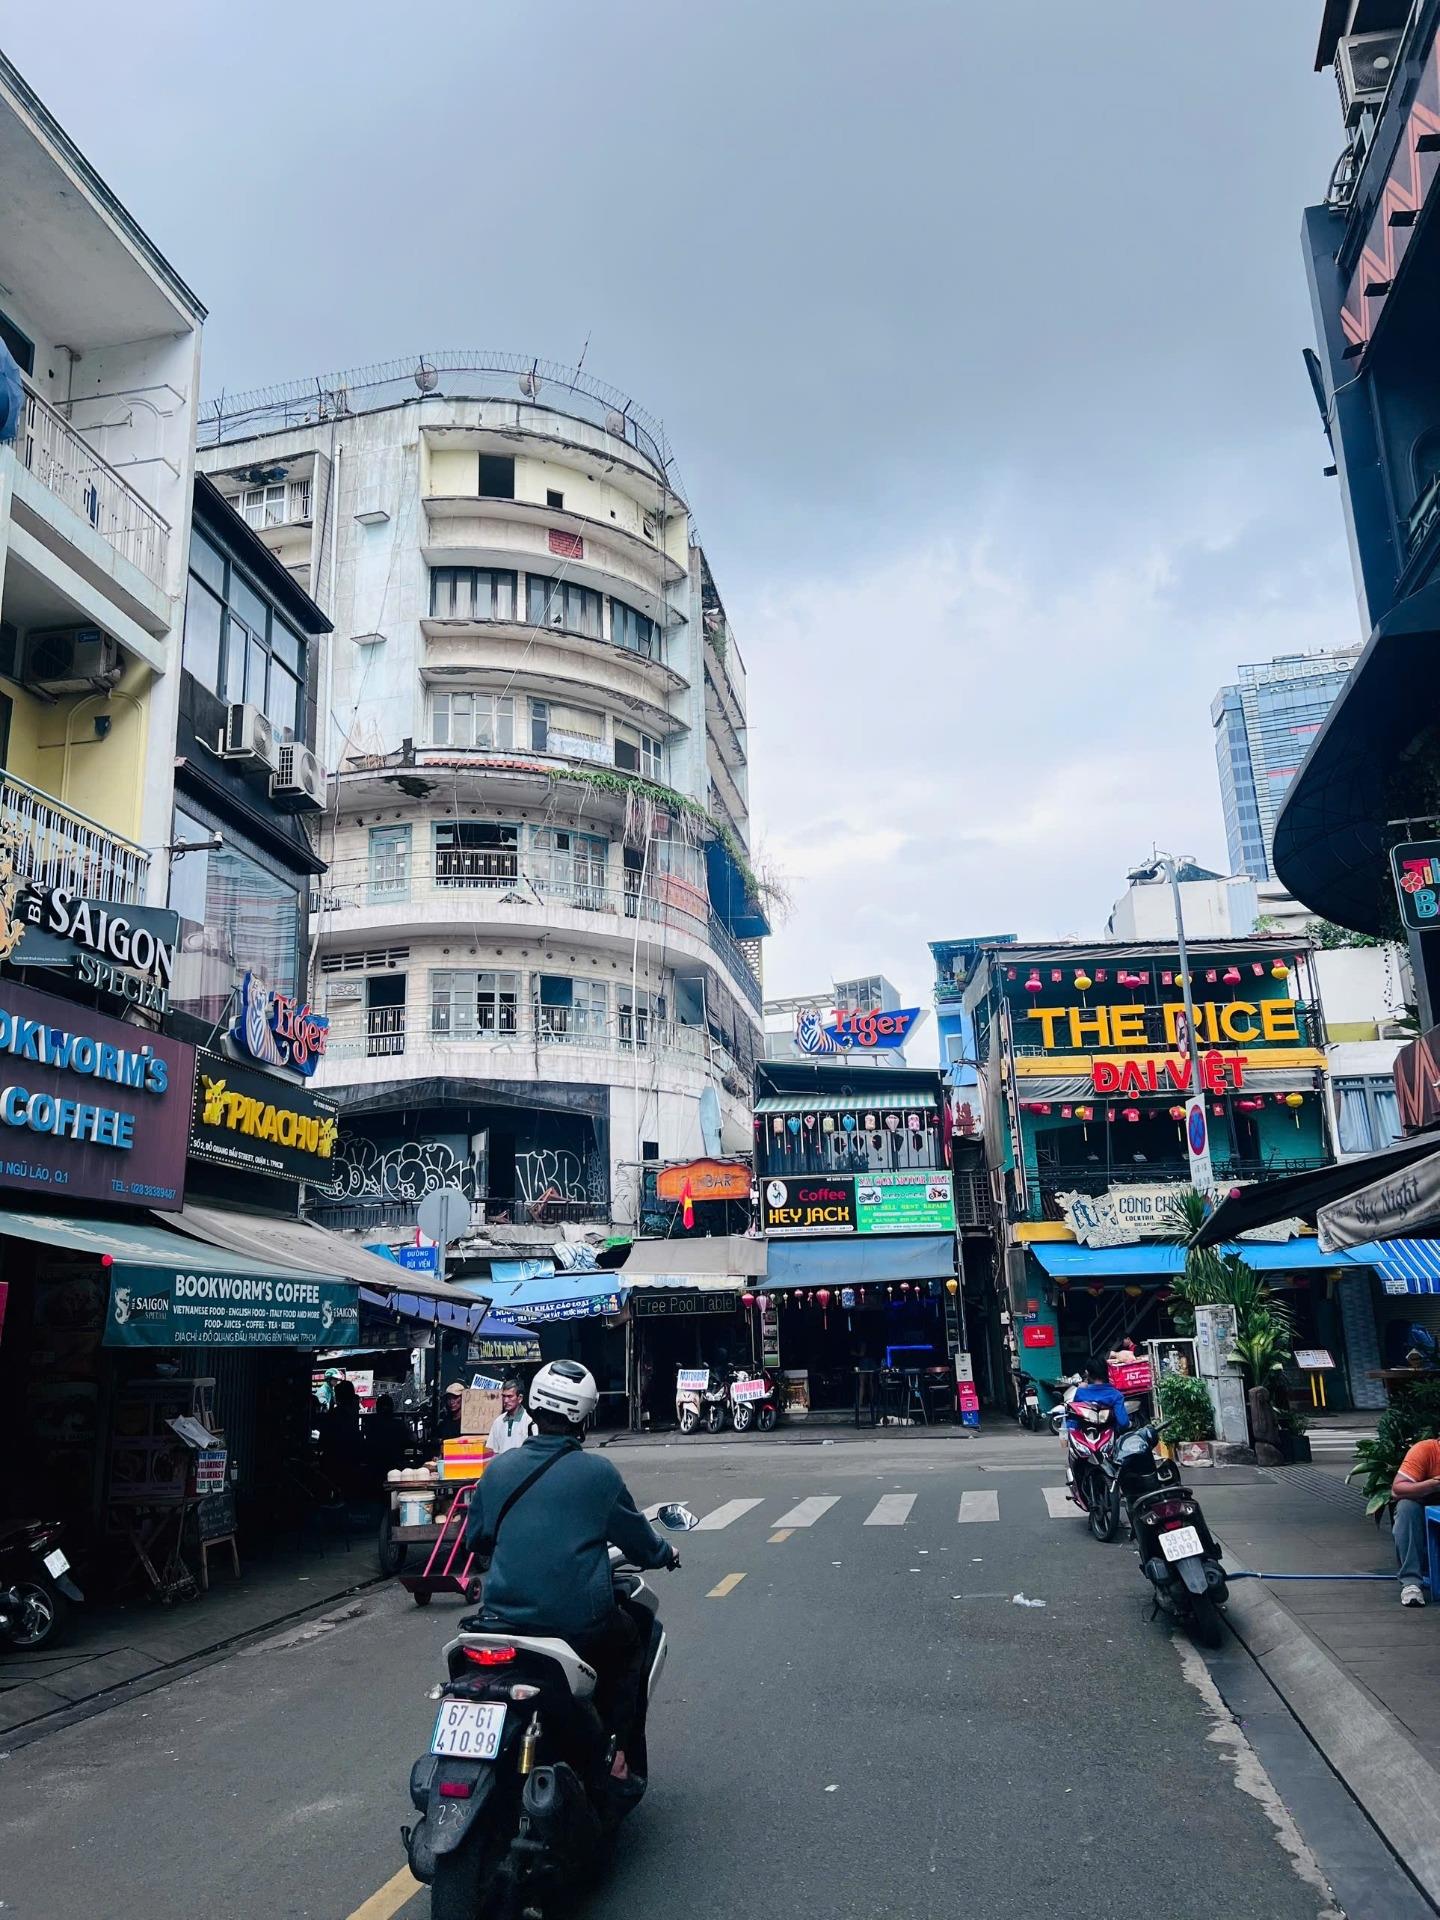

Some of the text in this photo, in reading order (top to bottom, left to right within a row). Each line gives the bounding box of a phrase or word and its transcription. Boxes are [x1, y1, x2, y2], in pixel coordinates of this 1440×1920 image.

[28, 881, 45, 924] BIA
[1414, 888, 1440, 918] B
[50, 887, 177, 983] SAIGON
[78, 952, 175, 1016] SPECIAL
[273, 991, 329, 1065] Tiger
[830, 997, 910, 1046] Tiger
[1028, 998, 1300, 1049] THE RICE
[1090, 1049, 1248, 1099] ĐẠI VIỆT
[0, 1086, 136, 1150] COFFEE
[227, 1092, 320, 1153] PIKACHU
[6, 1160, 28, 1178] NGŨ
[112, 1179, 128, 1193] TEL:
[799, 1187, 847, 1202] Coffee
[1119, 1195, 1151, 1214] CÔNG
[1355, 1175, 1423, 1226] Sky Night
[768, 1206, 850, 1226] HEY JACK
[175, 1274, 320, 1304] BOOKWORM'S COFFEE
[136, 1297, 169, 1311] SAIGON
[172, 1304, 208, 1316] VIETNAMESE
[209, 1306, 226, 1316] FOOD
[228, 1307, 252, 1317] ENGLISH
[252, 1308, 266, 1317] FOOD
[282, 1310, 297, 1318] FOOD
[336, 1308, 358, 1318] SAIGON
[639, 1295, 733, 1313] Free Pool Table
[223, 1320, 241, 1328] JUICES
[268, 1321, 278, 1329] TEA
[281, 1321, 295, 1329] BEERS
[736, 1390, 763, 1401] FOR SALE
[449, 1704, 494, 1729] 67-G1
[436, 1729, 497, 1754] 410.98
